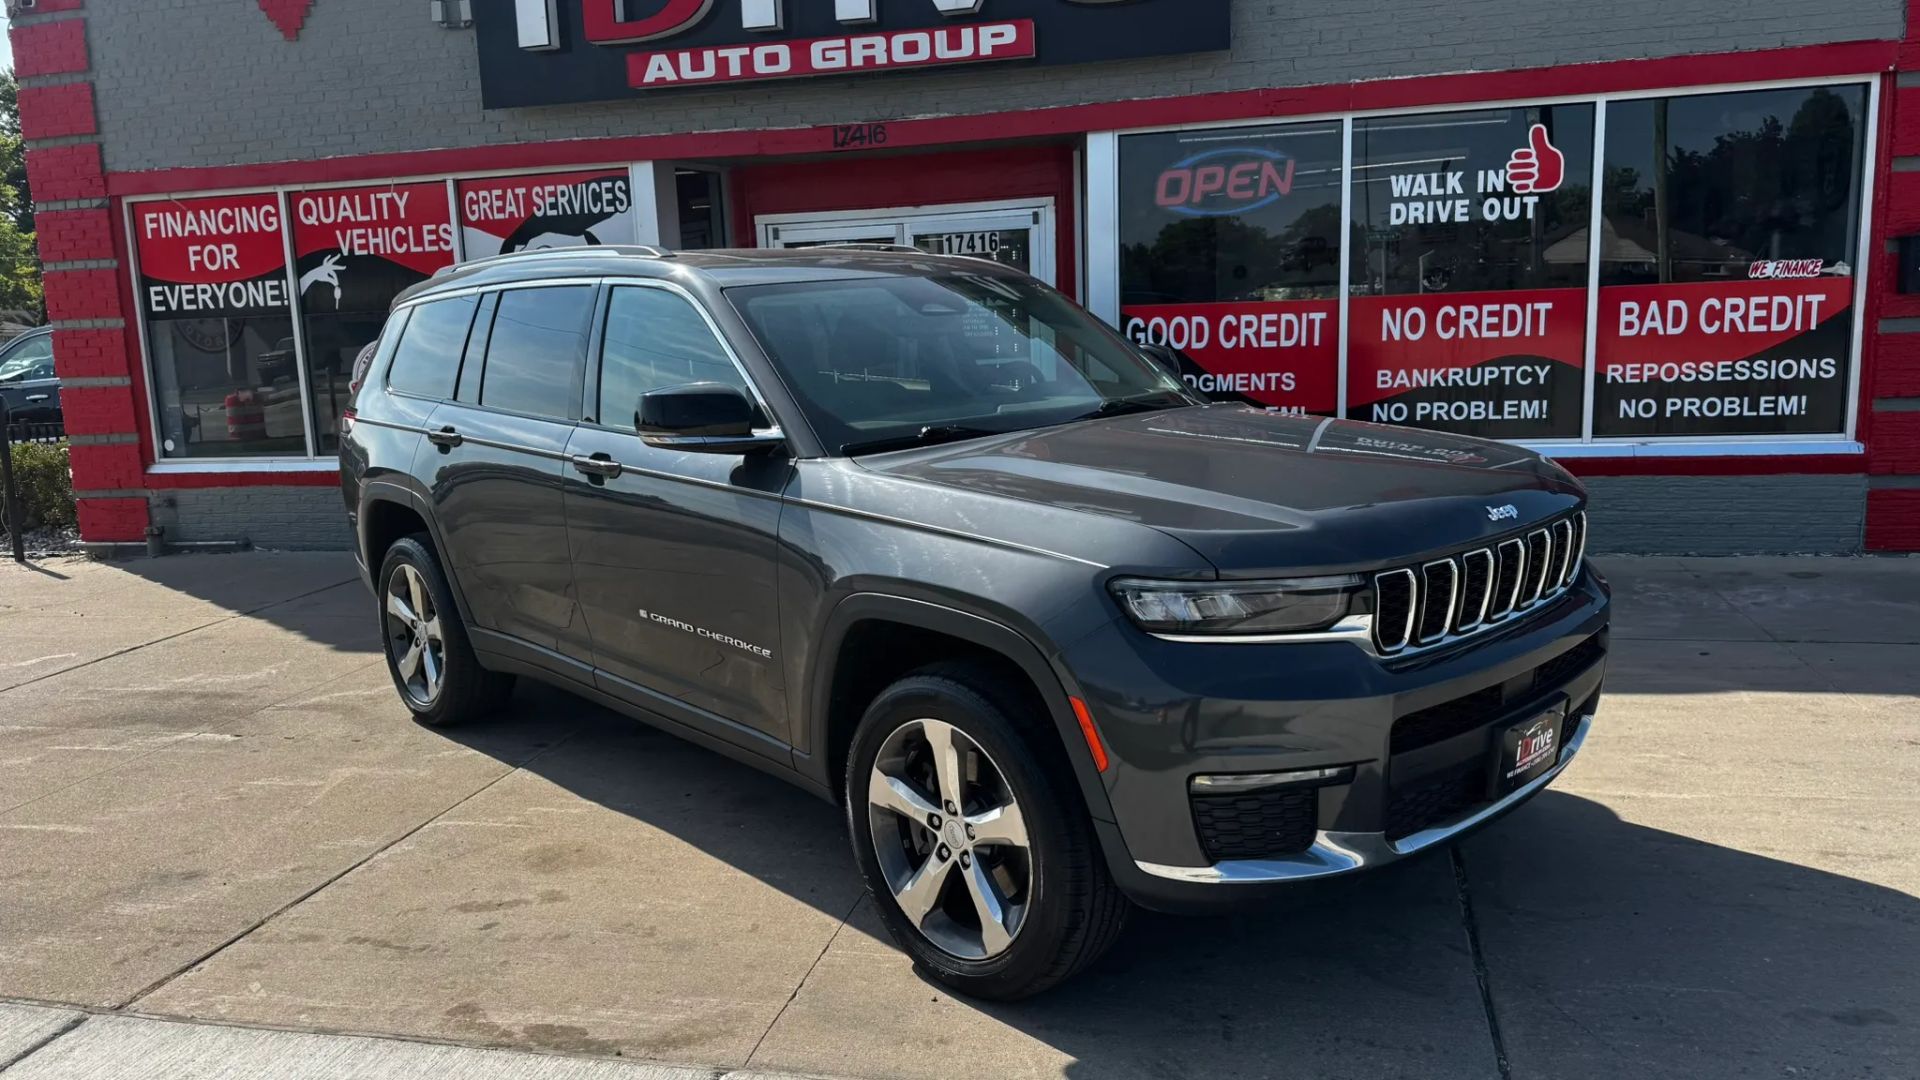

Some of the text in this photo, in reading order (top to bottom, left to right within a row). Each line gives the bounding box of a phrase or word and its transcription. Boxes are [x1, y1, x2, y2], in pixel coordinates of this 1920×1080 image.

[643, 23, 1017, 83] AUTO GROUP
[832, 124, 887, 148] 17416
[1155, 159, 1295, 207] OPEN
[1390, 169, 1505, 197] WALK IN
[299, 190, 410, 226] QUALITY
[465, 180, 629, 222] GREAT SERVICES
[1389, 196, 1539, 226] DRIVE OUT
[144, 204, 278, 240] FINANCING
[335, 222, 453, 257] VEHICLES
[945, 232, 999, 255] 17416
[188, 243, 241, 272] FOR
[1749, 259, 1823, 278] WE FINANCE
[149, 279, 289, 312] EVERYONE!
[1126, 311, 1327, 350] GOOD CREDIT
[1381, 302, 1553, 342] NO CREDIT
[1619, 294, 1826, 337] BAD CREDIT
[1183, 372, 1296, 392] DGMENTS
[1376, 365, 1552, 389] BANKRUPTCY
[1607, 358, 1836, 383] REPOSSESSIONS
[1373, 399, 1548, 422] NO PROBLEM!
[1619, 395, 1807, 419] NO PROBLEM!
[1485, 504, 1518, 521] Jeep
[650, 613, 772, 659] GRAND CHEROKEE
[1516, 728, 1553, 761] iDrive
